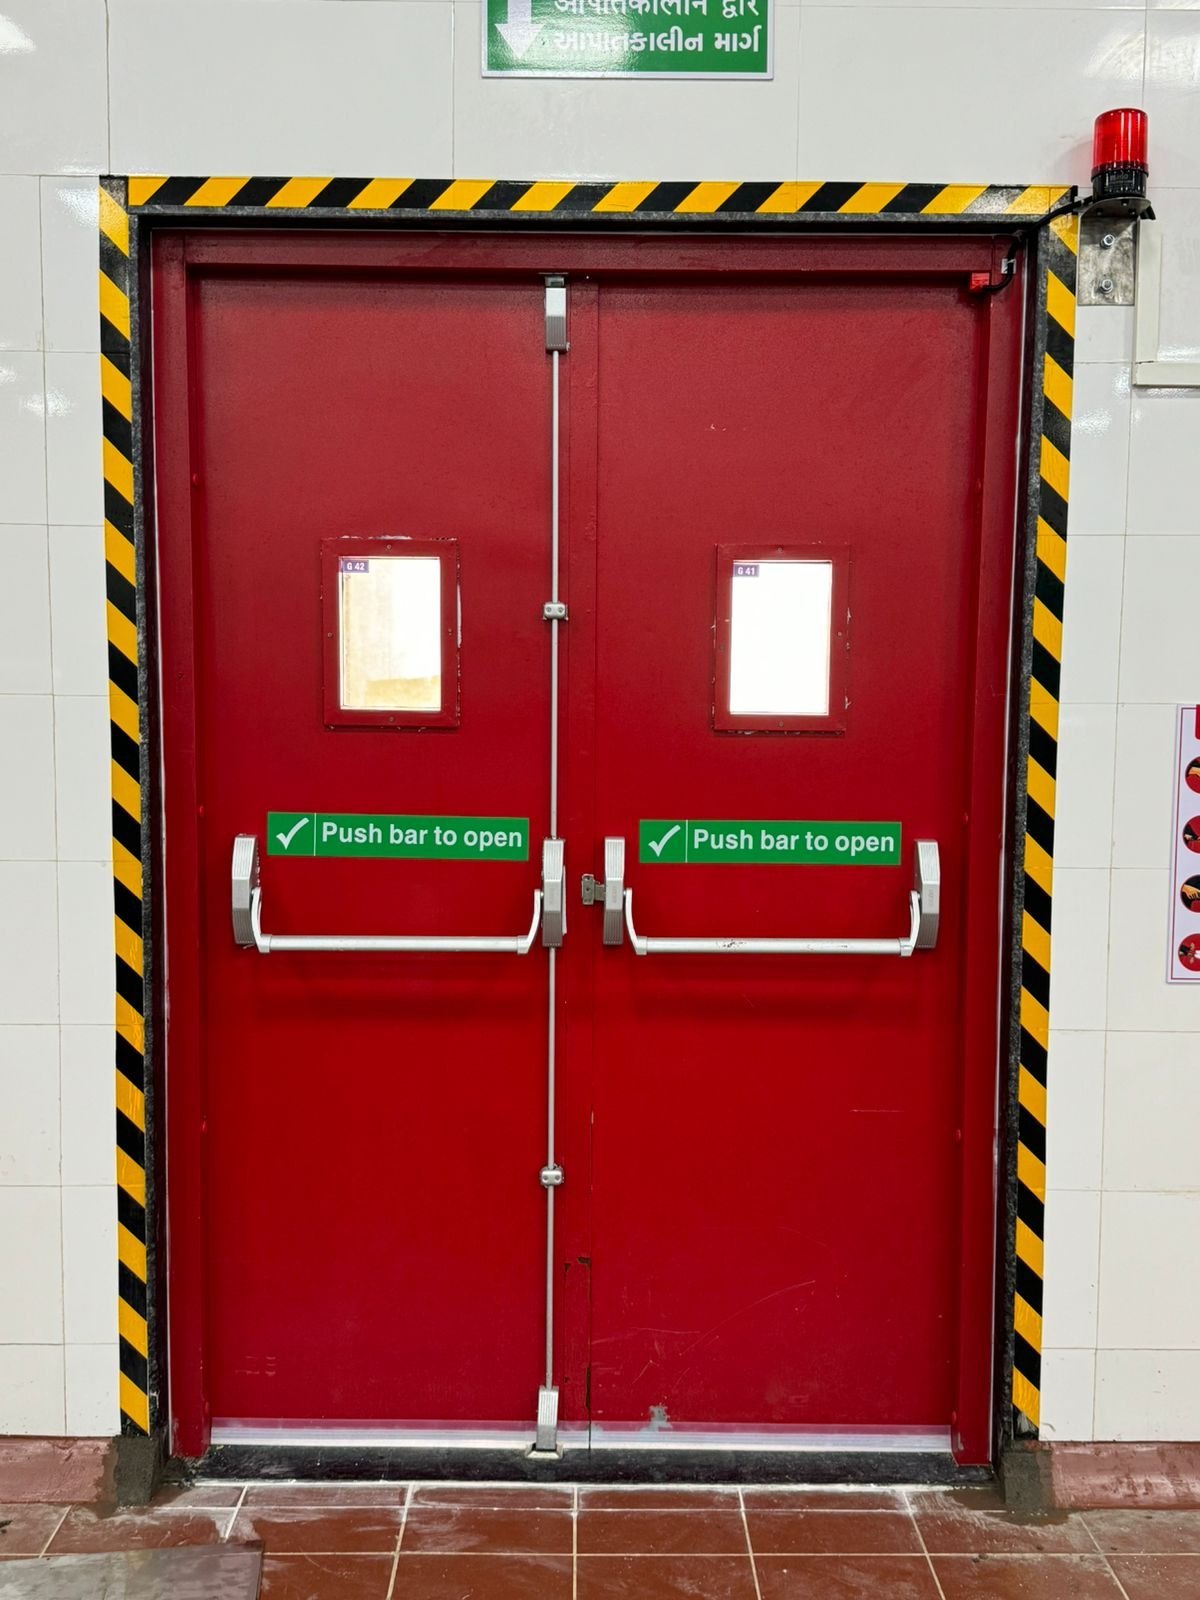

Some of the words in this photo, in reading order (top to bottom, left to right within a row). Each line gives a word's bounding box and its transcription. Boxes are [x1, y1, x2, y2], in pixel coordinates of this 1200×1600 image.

[714, 25, 762, 52] માર્ગ
[346, 562, 353, 570] G
[354, 562, 365, 570] 42
[745, 567, 755, 575] 41
[321, 822, 382, 844] Push
[389, 824, 428, 846] bar
[433, 826, 457, 846] to
[463, 831, 522, 851] open
[693, 829, 753, 850] Push
[760, 830, 799, 850] bar
[805, 832, 828, 851] to
[835, 835, 894, 856] open
